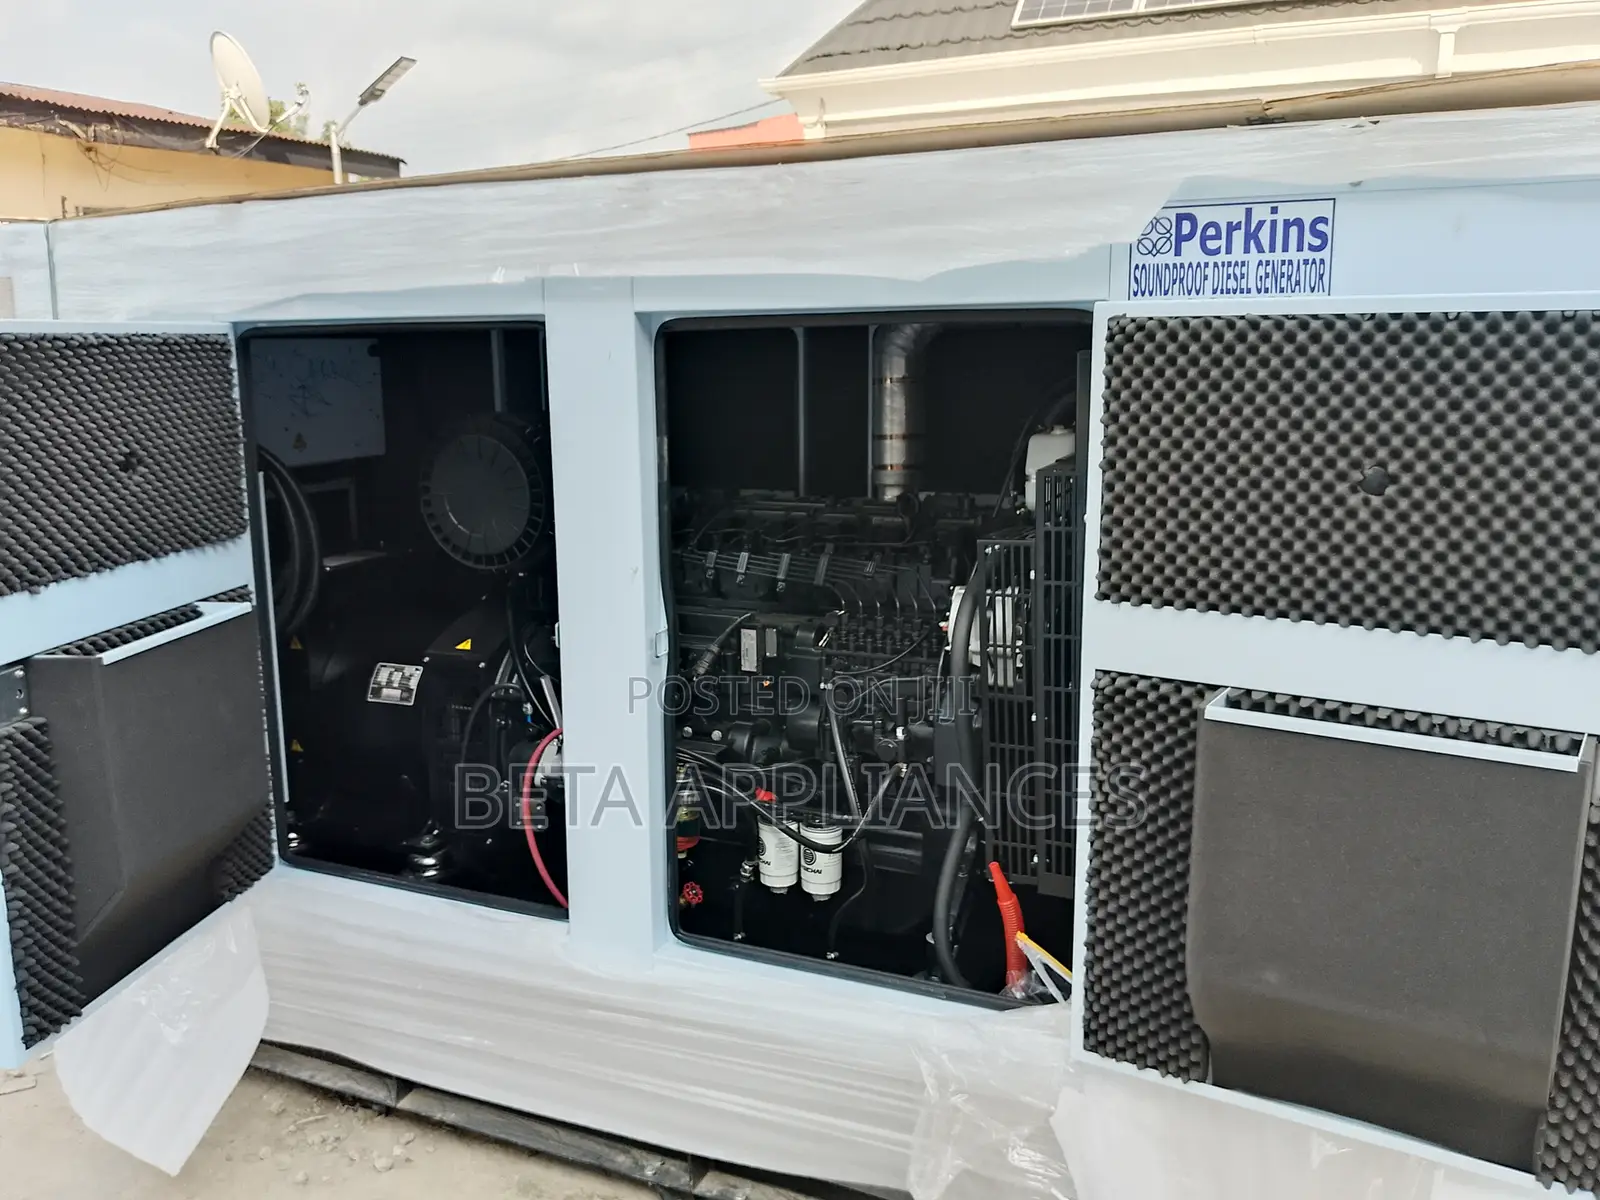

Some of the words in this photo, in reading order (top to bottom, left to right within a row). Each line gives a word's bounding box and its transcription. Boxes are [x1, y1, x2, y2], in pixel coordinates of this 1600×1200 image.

[1174, 206, 1328, 256] Perkins
[1132, 262, 1208, 297] SOUNDPROOF
[1212, 261, 1251, 294] DIESEL
[1256, 259, 1325, 294] GENERATOR
